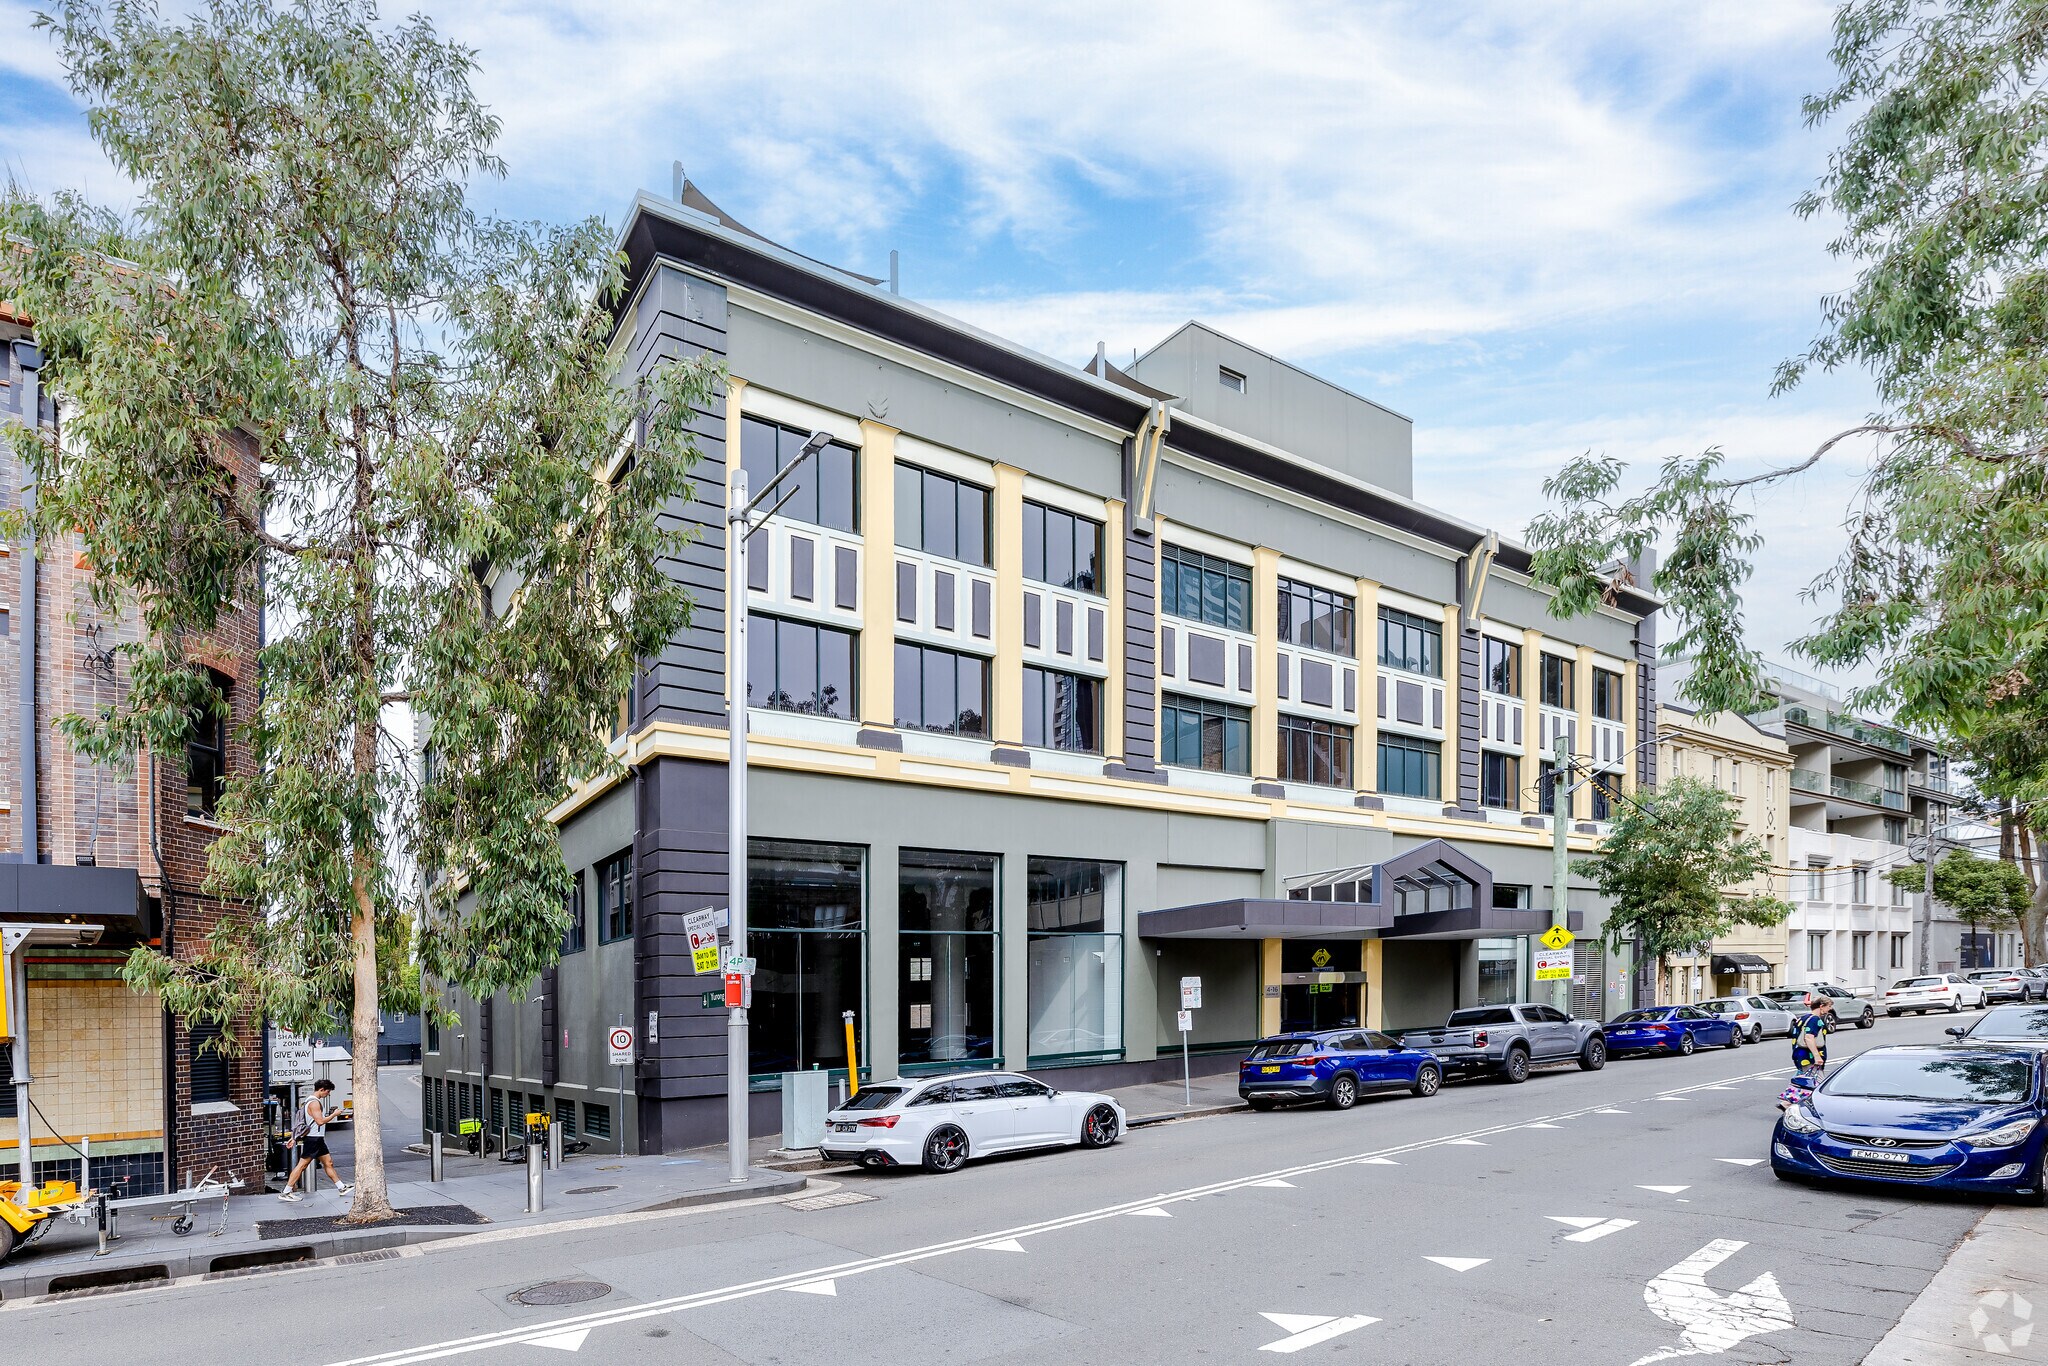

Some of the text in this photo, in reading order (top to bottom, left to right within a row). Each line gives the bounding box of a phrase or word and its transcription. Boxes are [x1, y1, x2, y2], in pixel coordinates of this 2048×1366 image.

[688, 913, 710, 925] CLEARWAY
[687, 922, 702, 933] SPECIAL
[701, 920, 714, 929] EVENTS
[729, 957, 743, 965] 4P
[616, 1035, 626, 1043] 10
[274, 1051, 292, 1059] GIVE
[273, 1069, 312, 1077] PEDESTRIANS
